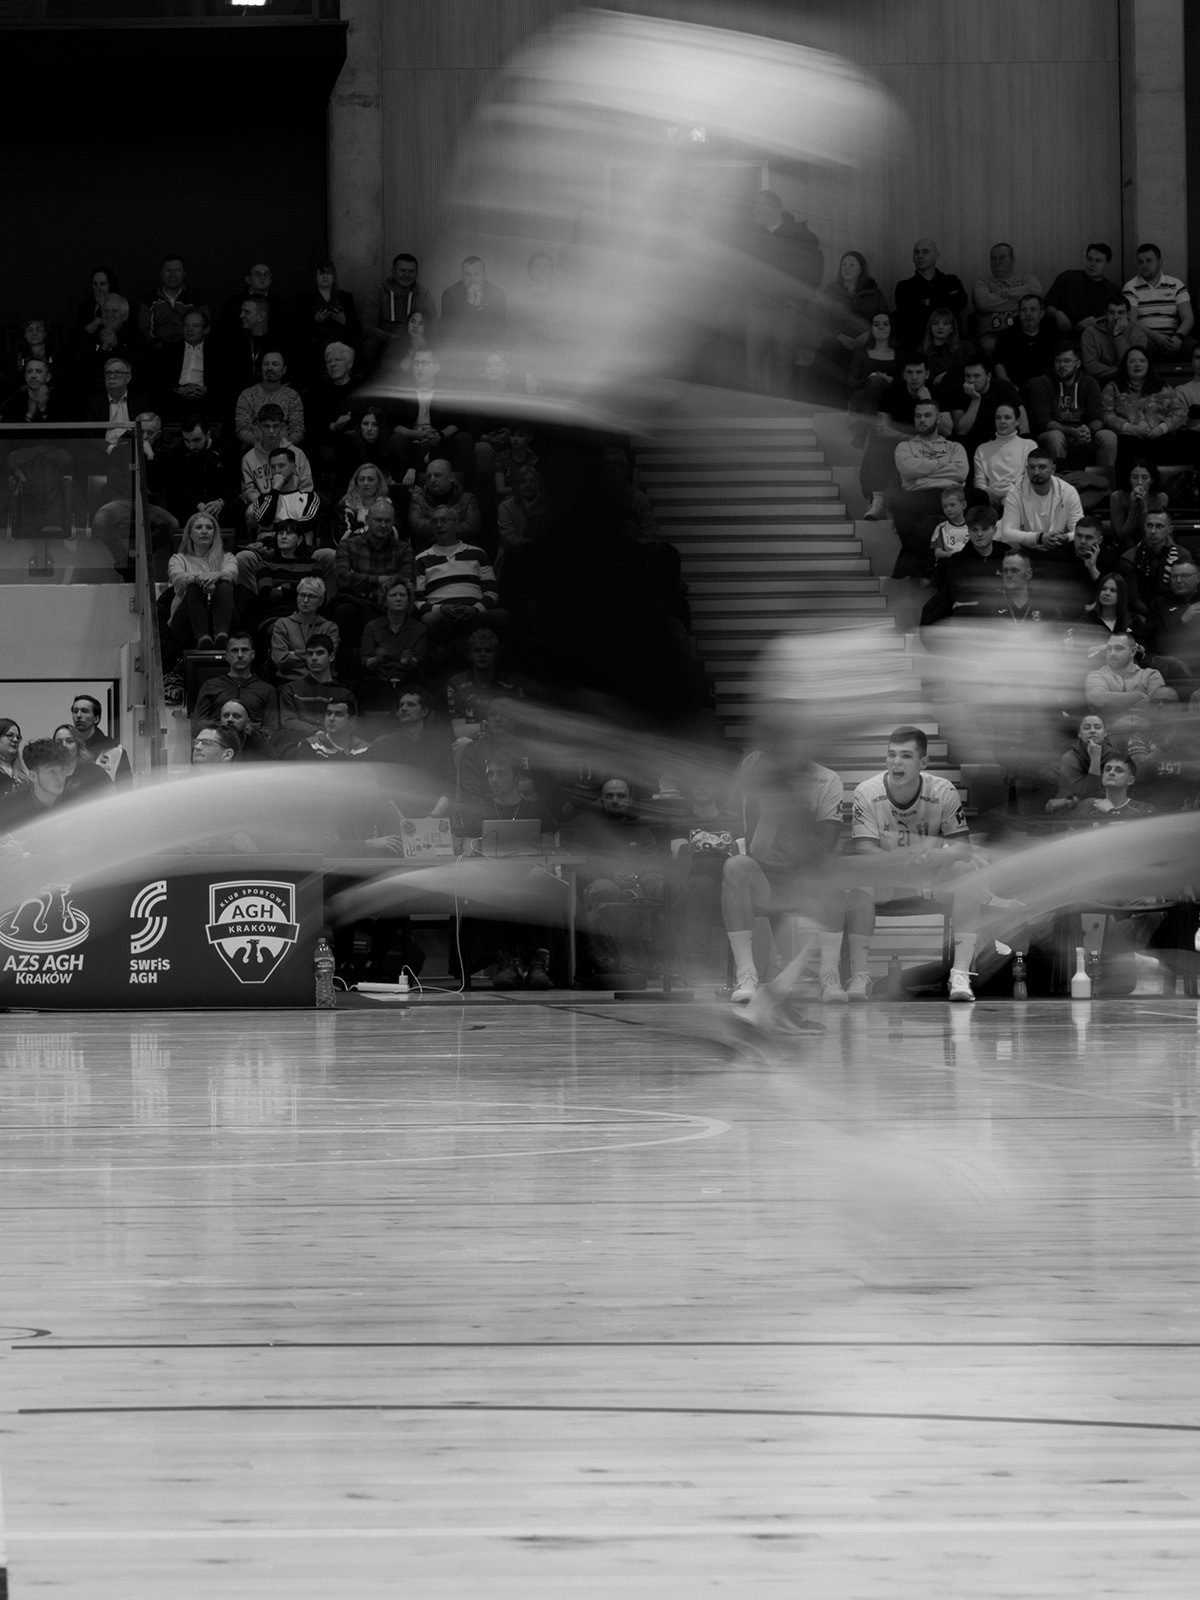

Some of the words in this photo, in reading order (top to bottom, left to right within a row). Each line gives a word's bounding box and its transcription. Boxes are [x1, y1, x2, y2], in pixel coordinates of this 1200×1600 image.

[897, 830, 910, 847] 21
[220, 892, 239, 908] KLUB
[242, 888, 286, 908] SPORTOWY
[232, 904, 274, 919] AGH
[228, 923, 277, 933] KRAKÓW
[3, 954, 40, 972] AZS
[42, 954, 84, 971] AGH
[129, 957, 171, 971] SWFiS
[129, 972, 158, 984] AGH
